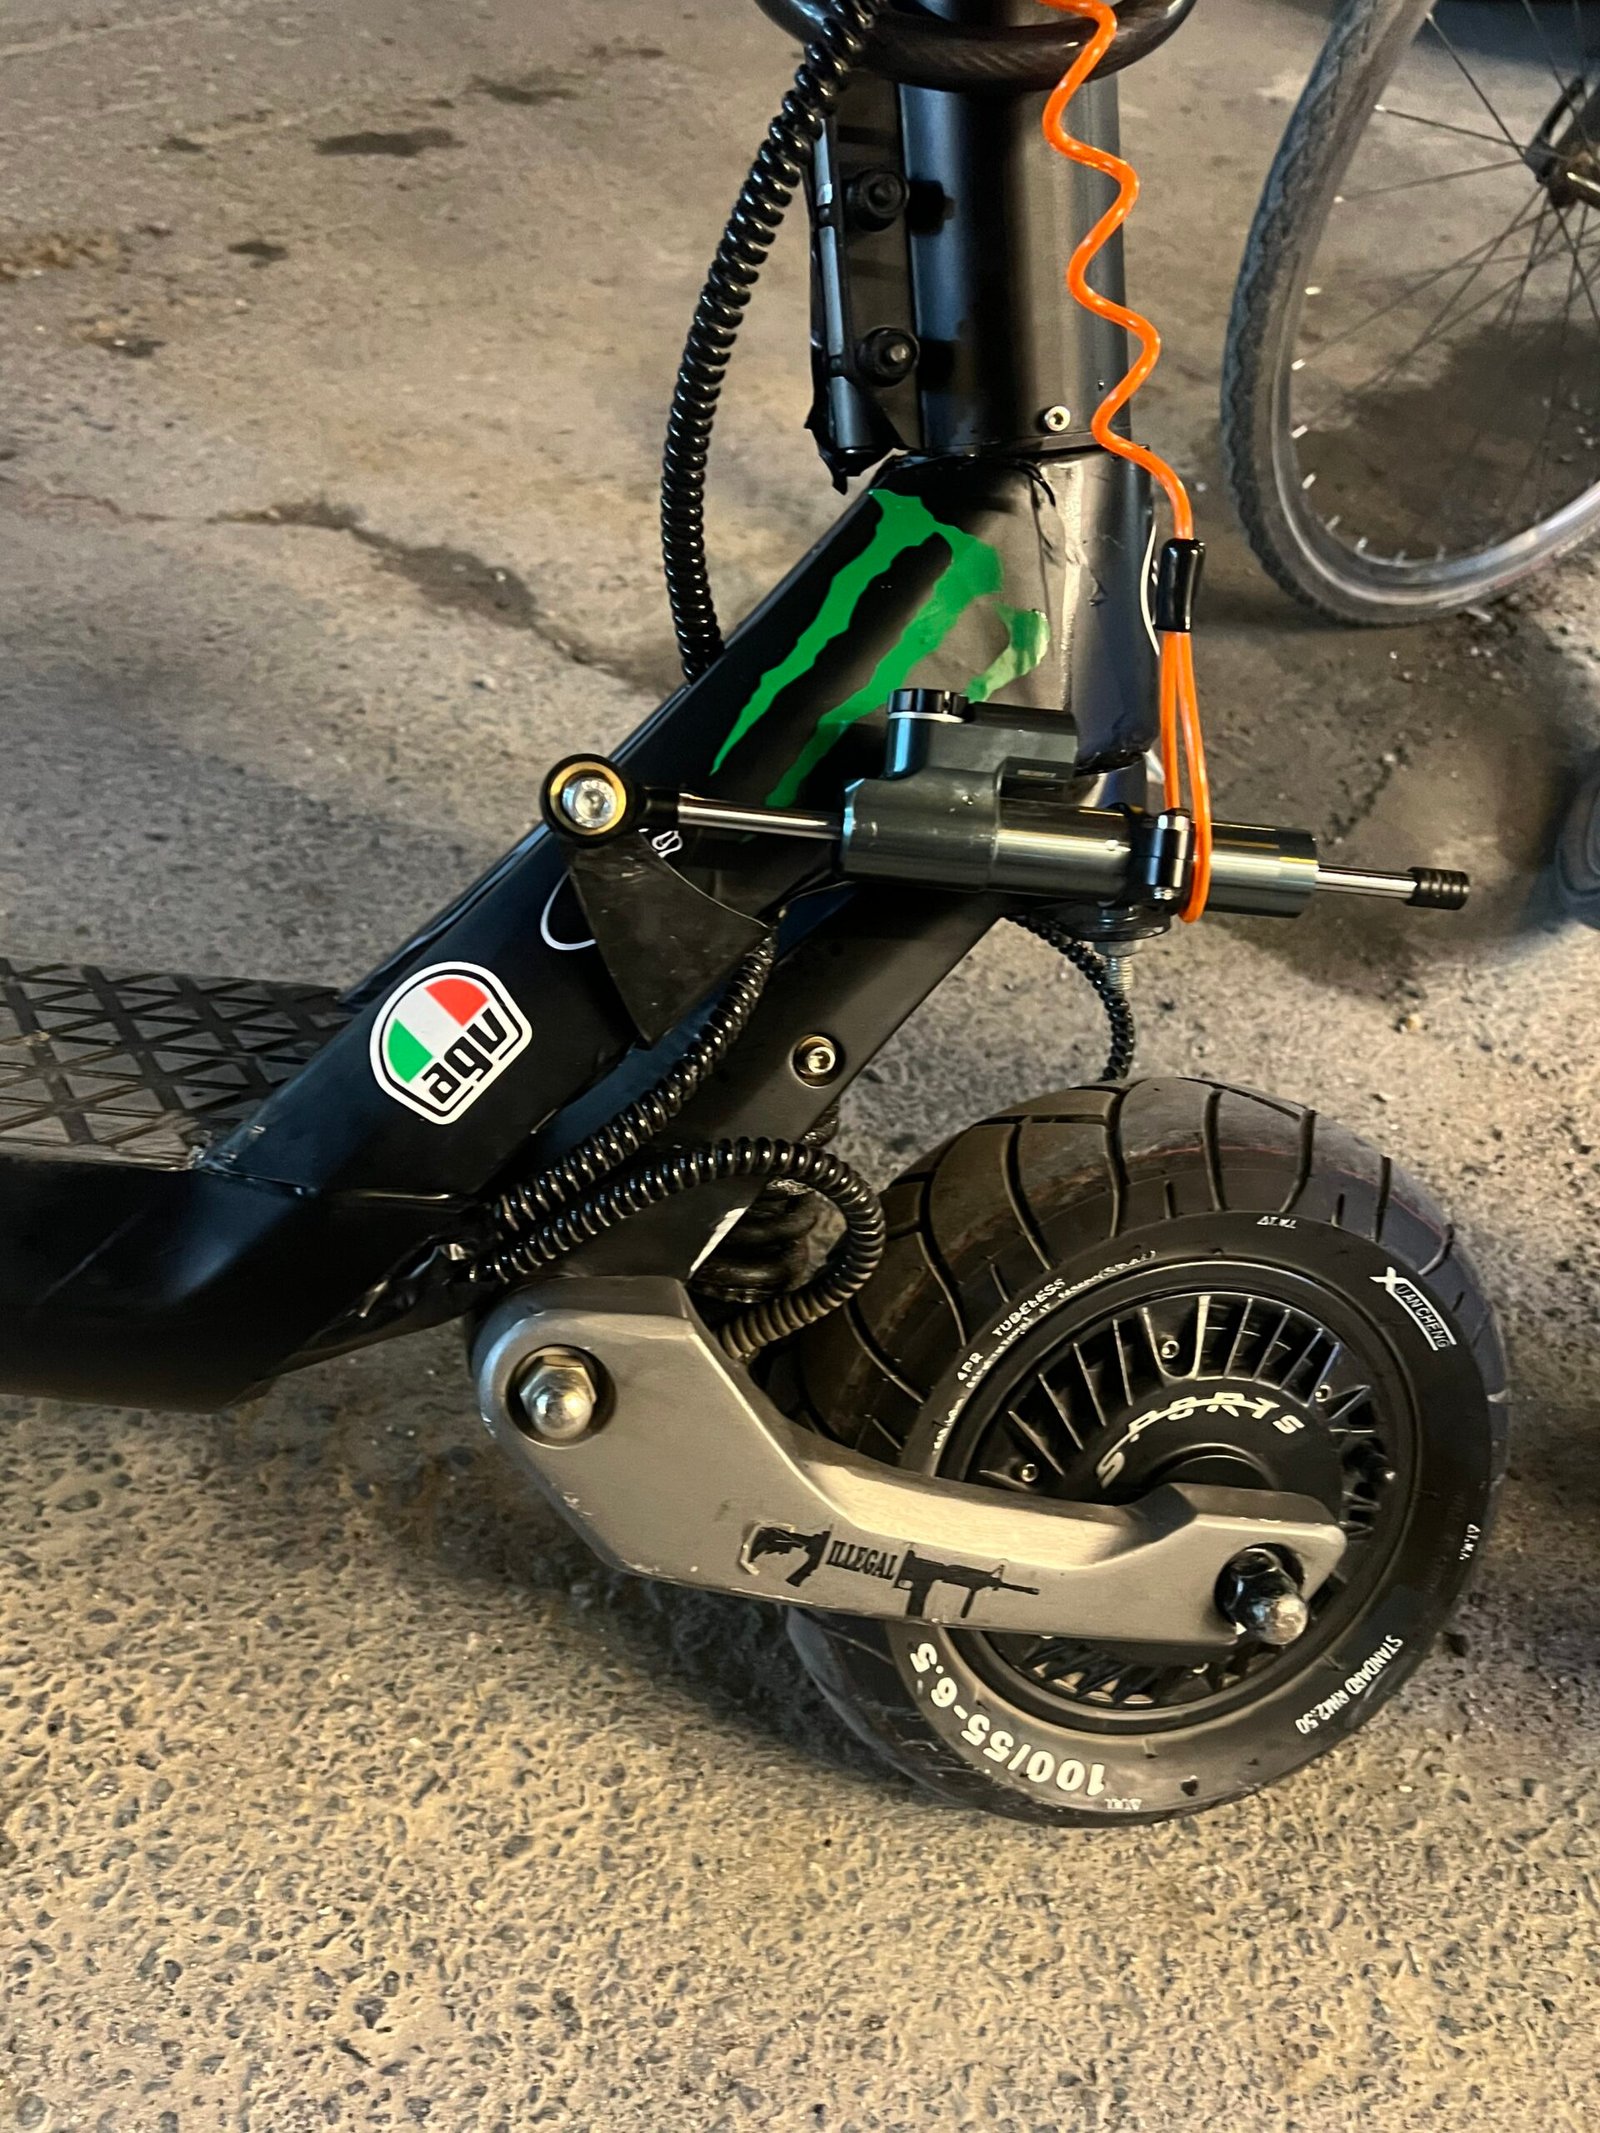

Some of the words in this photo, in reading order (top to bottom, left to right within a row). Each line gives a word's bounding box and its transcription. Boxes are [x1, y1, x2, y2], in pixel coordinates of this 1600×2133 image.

[421, 1007, 507, 1104] agv
[956, 1352, 984, 1382] 4PR
[992, 1279, 1066, 1337] TUBELESS
[826, 1540, 898, 1580] ILLEGAL
[1344, 1634, 1403, 1695] STANDARD
[910, 1642, 1105, 1796] 100/55-6.5
